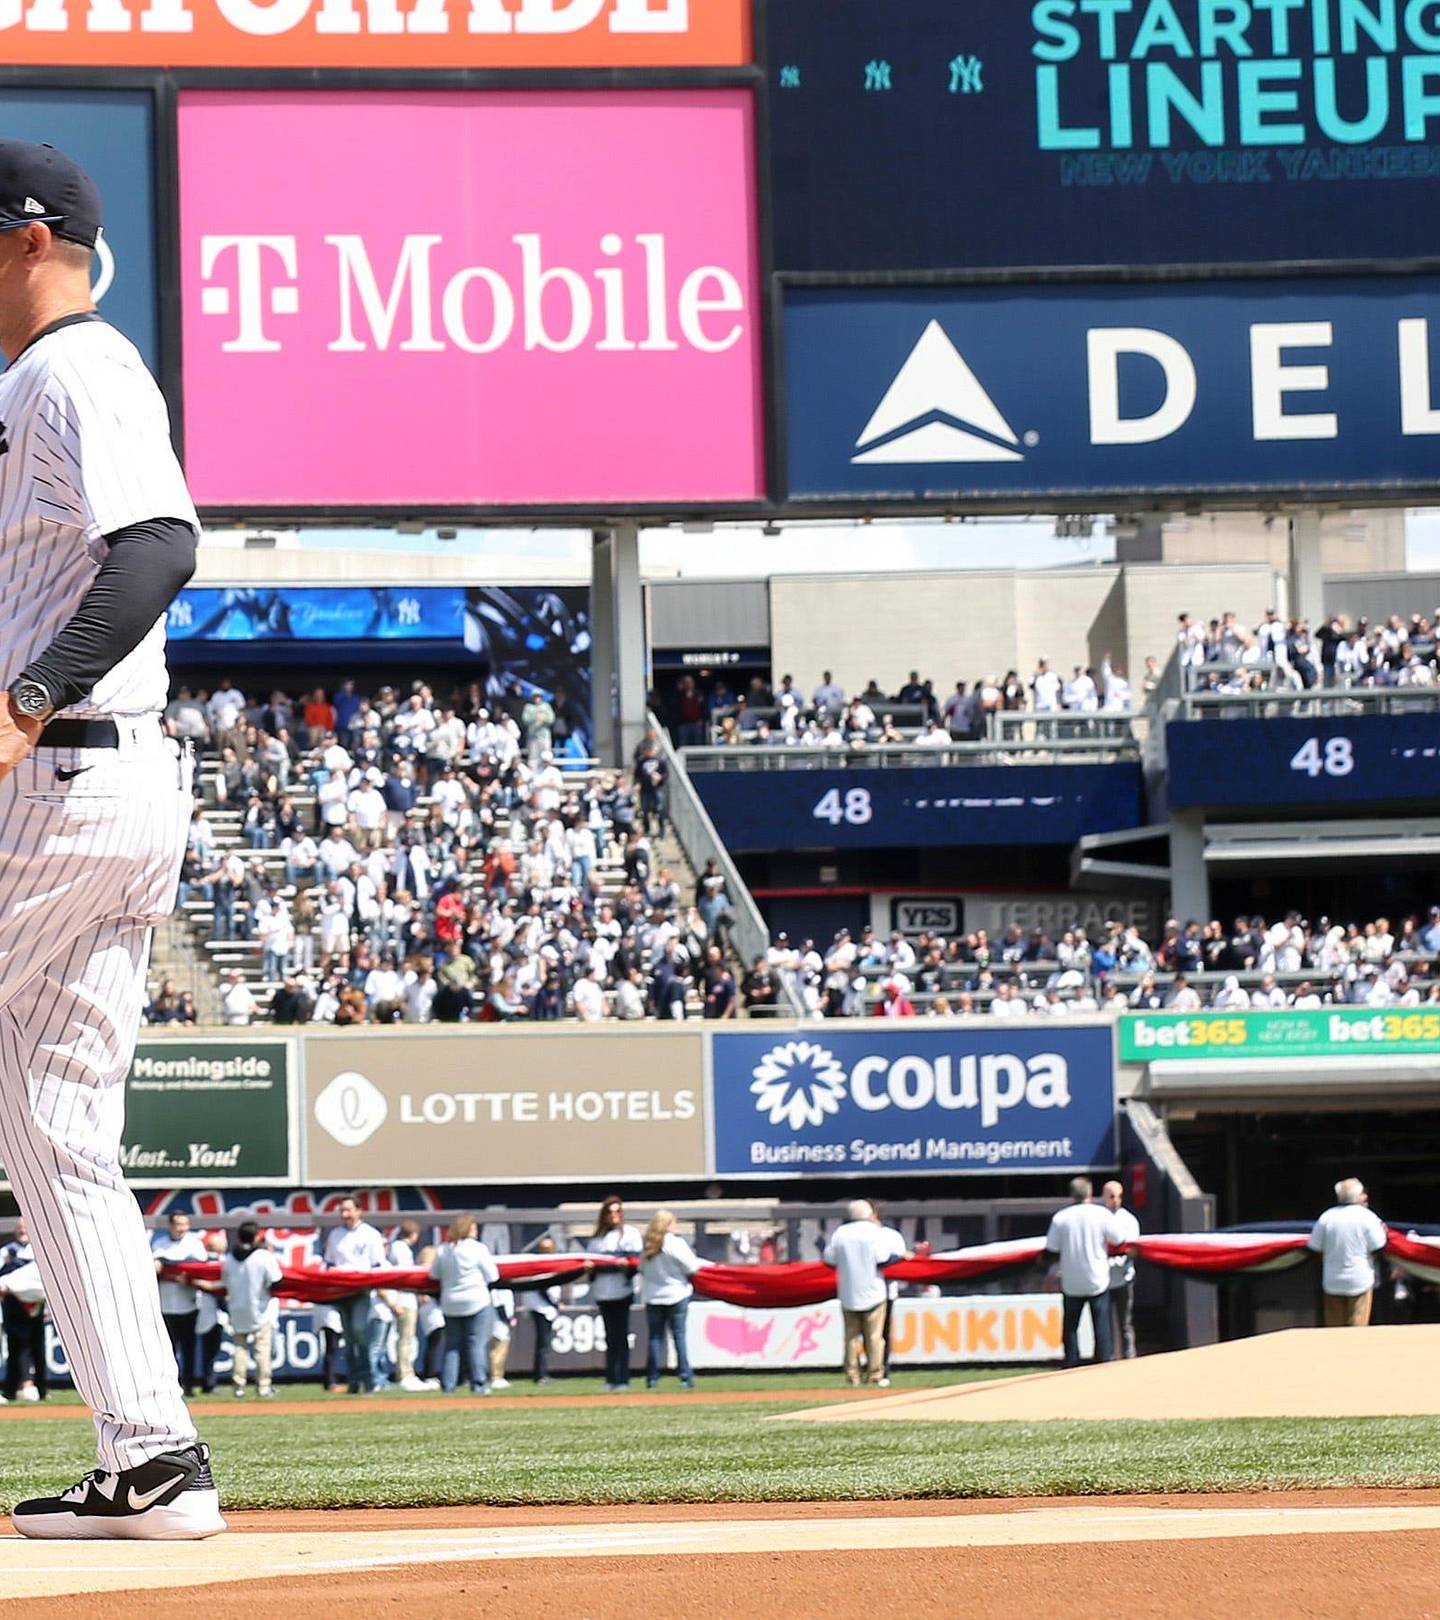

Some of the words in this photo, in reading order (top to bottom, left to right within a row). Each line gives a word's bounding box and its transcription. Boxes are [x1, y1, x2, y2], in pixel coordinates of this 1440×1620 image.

[1060, 153, 1153, 186] NEW
[1160, 150, 1270, 183] YORK
[324, 233, 744, 353] Mobile
[1290, 737, 1355, 778] 48
[812, 788, 873, 825] 48
[902, 907, 952, 927] YES
[990, 902, 1150, 933] TERRACE
[1133, 1018, 1248, 1047] bet365
[1329, 1014, 1440, 1042] bet365
[134, 1056, 271, 1081] Morningside
[399, 1091, 539, 1125] LOTTE
[548, 1089, 696, 1122] HOTELS
[850, 1053, 1072, 1128] coupa
[750, 1140, 846, 1164] Business
[850, 1138, 921, 1165] Spend
[925, 1137, 1073, 1164] Management
[891, 1307, 1064, 1355] UNKIN
